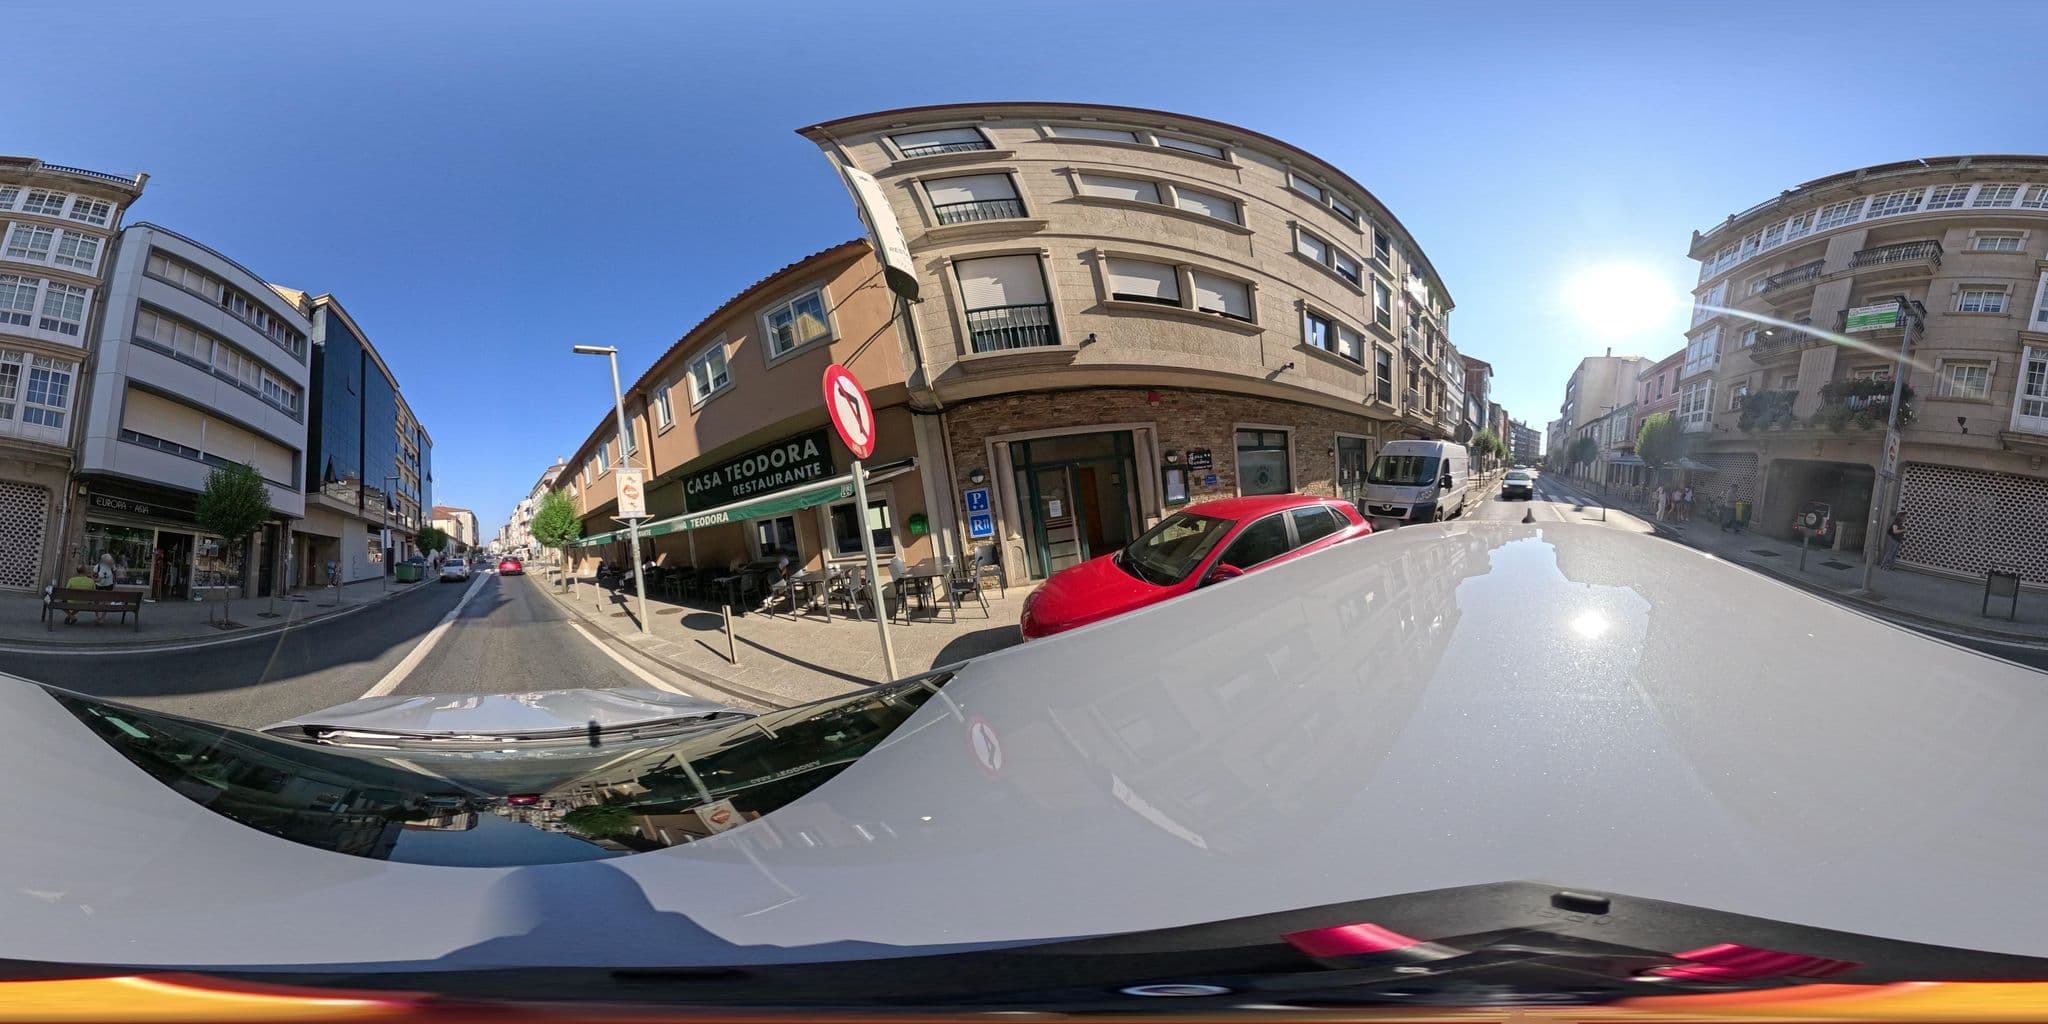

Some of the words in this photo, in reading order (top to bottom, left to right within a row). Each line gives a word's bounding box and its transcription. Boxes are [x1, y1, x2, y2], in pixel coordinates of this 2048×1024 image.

[686, 471, 722, 495] CASA
[724, 438, 820, 482] TEODORA
[732, 462, 822, 497] RESTAURANTE
[96, 496, 127, 511] EUROPA
[972, 492, 982, 504] P
[690, 511, 729, 529] TEODORA
